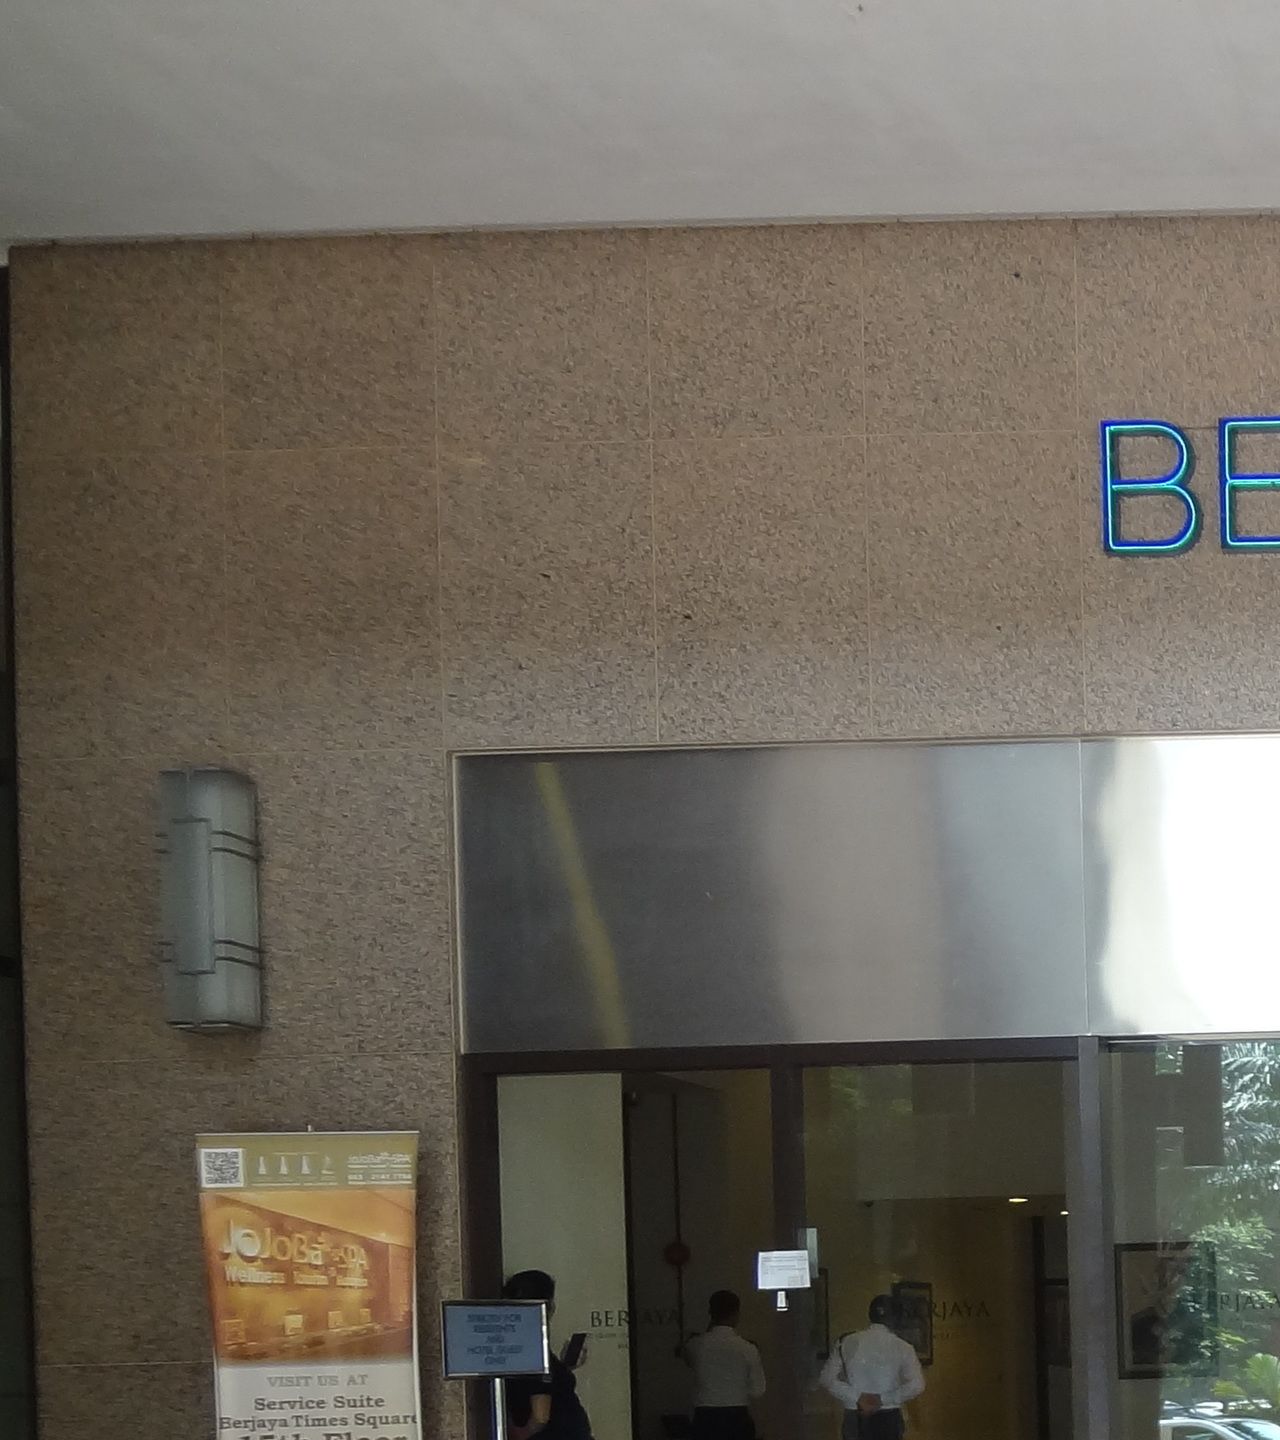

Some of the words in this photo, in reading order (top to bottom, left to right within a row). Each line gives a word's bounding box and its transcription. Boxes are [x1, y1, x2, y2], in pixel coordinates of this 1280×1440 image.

[267, 1376, 313, 1387] VISIT
[317, 1375, 340, 1386] US
[346, 1374, 369, 1385] AT
[254, 1396, 326, 1411] Service
[333, 1394, 385, 1409] Suite
[219, 1416, 288, 1432] Berjaya
[291, 1414, 348, 1428] Times
